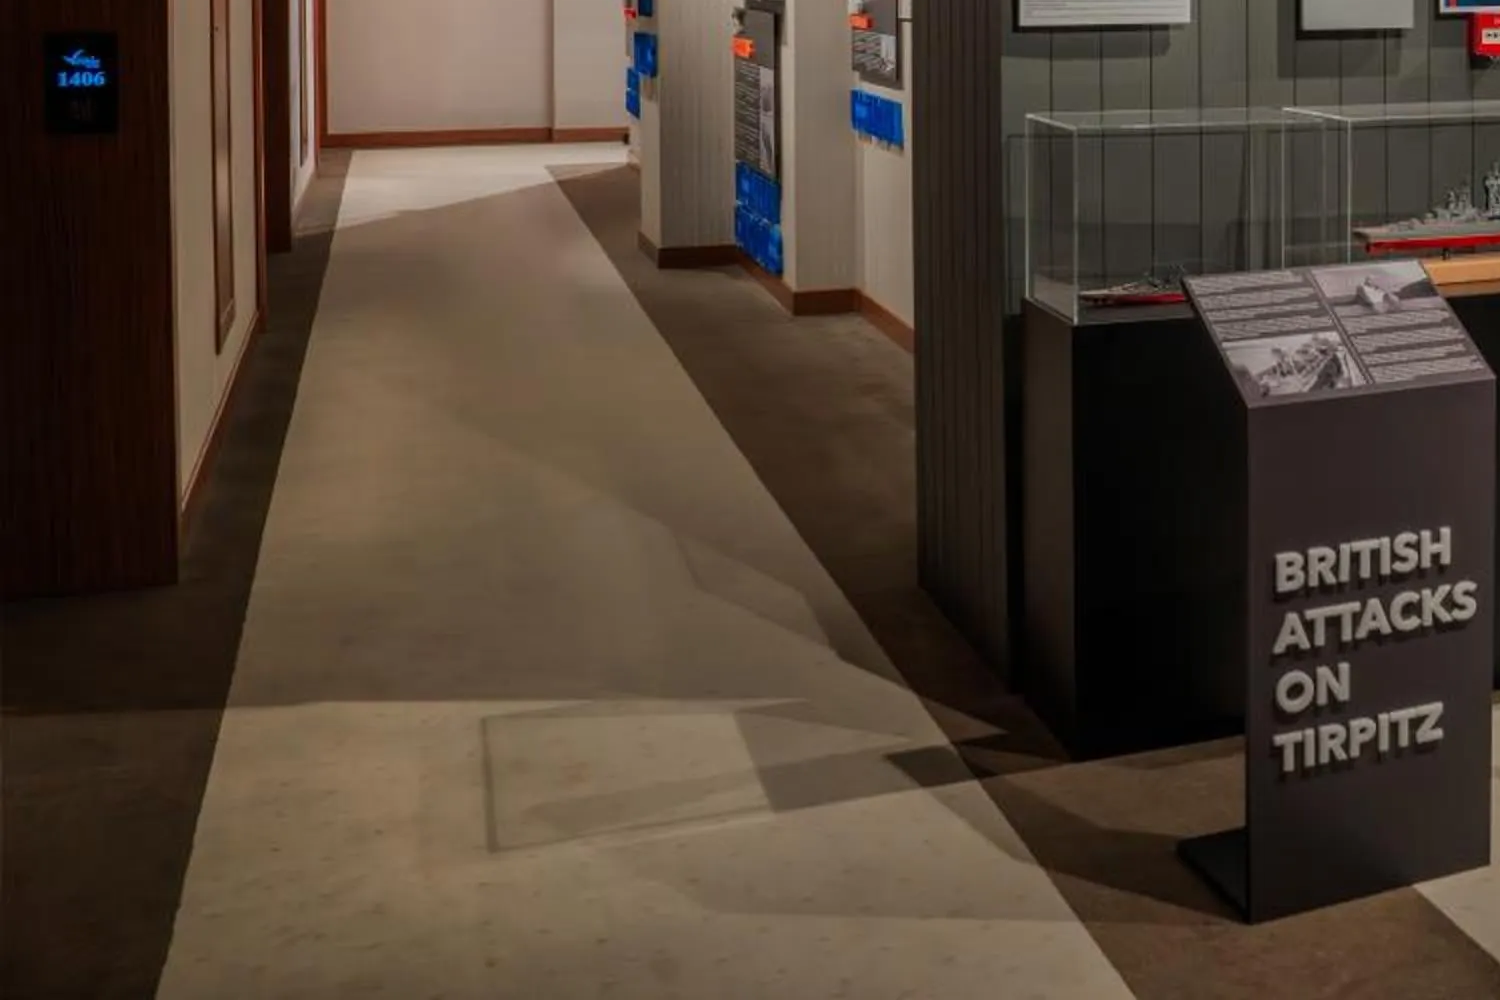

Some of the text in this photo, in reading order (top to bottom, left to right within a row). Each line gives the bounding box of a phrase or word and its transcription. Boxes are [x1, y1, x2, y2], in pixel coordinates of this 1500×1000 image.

[57, 71, 106, 87] 1406
[1274, 525, 1452, 594] BRITISH
[1272, 579, 1478, 655] ATTACKS
[1275, 661, 1351, 714] ON
[1272, 700, 1445, 773] TIRPITZ
